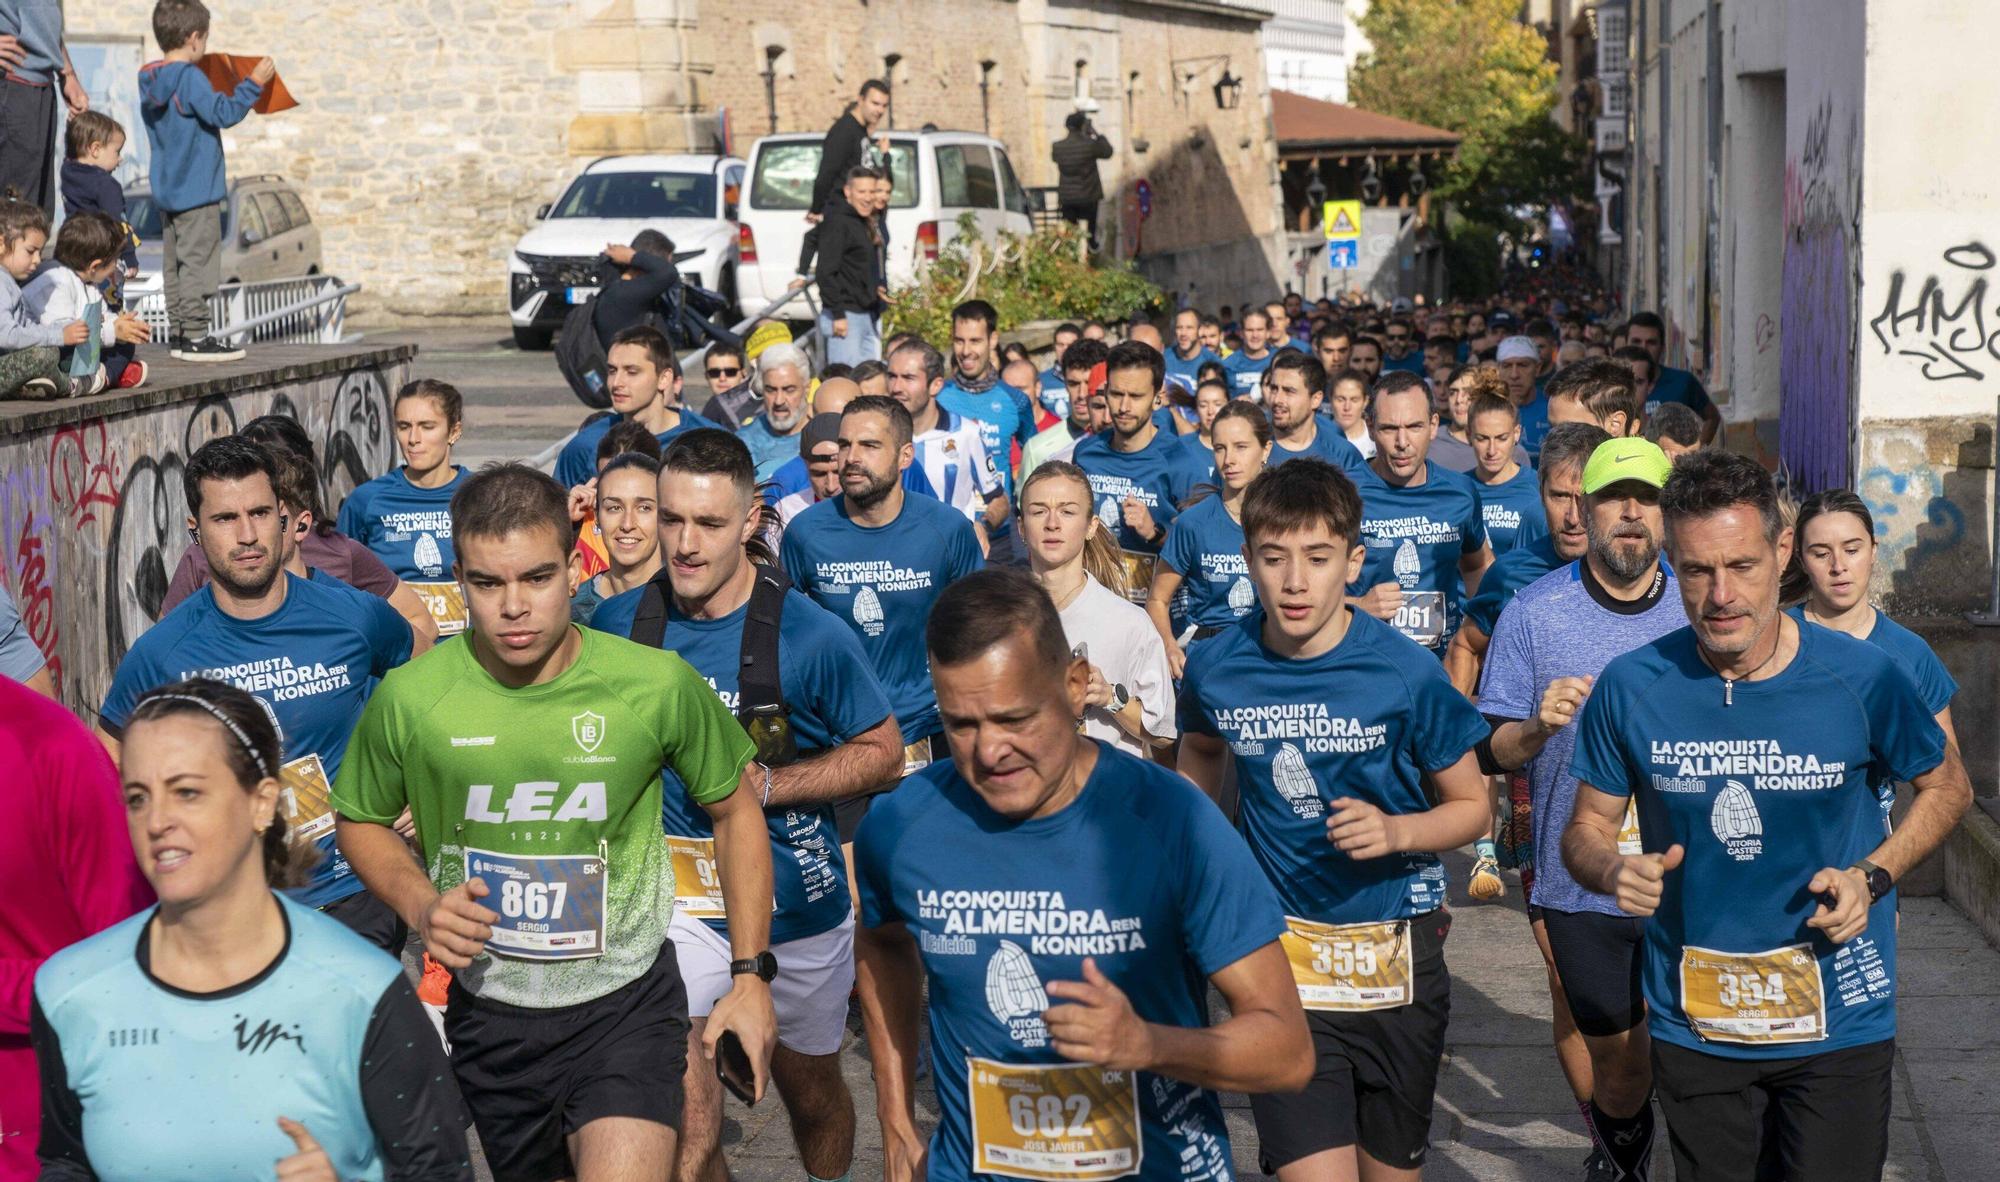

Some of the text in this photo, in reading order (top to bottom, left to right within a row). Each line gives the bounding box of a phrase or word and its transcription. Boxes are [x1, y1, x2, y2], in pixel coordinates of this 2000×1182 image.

[1089, 475, 1132, 486] CONQUISTA
[380, 511, 450, 522] LA CONQUISTA
[1360, 516, 1430, 528] LA CONQUISTA
[396, 520, 452, 532] ALMEND
[1378, 522, 1452, 538] ALMENDRA
[1417, 534, 1460, 544] KONKISTA
[1201, 553, 1212, 561] LA
[816, 560, 892, 572] LA CONQUISTA
[1214, 563, 1250, 574] ALME
[833, 568, 916, 584] ALMENDRA
[877, 578, 932, 592] KONKISTA
[202, 656, 294, 680] CONQUISTA
[234, 663, 348, 693] MENDRA REN
[273, 674, 351, 702] KONKISTA
[1214, 704, 1328, 722] LA CONQUISTA
[1218, 718, 1386, 740] DE LA ALMENDRA REN
[1306, 734, 1386, 752] KONKISTA
[1652, 740, 1782, 758] LA CONQUISTA
[298, 764, 316, 776] 10K
[1652, 754, 1846, 776] DE LA ALMENDRA REN
[1663, 775, 1706, 792] Edición
[1754, 772, 1844, 790] KONKISTA
[464, 781, 608, 824] LEA
[1291, 798, 1322, 807] VITORIA
[1294, 804, 1325, 814] GASTEIZ
[788, 824, 814, 838] LABORAL
[1727, 840, 1762, 848] VITORIA
[1727, 846, 1762, 856] GASTEIZ
[583, 864, 598, 874] 5K
[501, 880, 568, 920] 867
[916, 890, 1066, 912] LA CONQUISTA
[516, 922, 550, 933] SERGIO
[920, 908, 1142, 934] DE LA ALMENDRA REN
[929, 934, 977, 954] Edición
[1031, 932, 1147, 956] KONKISTA
[1311, 941, 1378, 976] 355
[1792, 954, 1808, 966] 10K
[1718, 972, 1788, 1007] 354
[1738, 1008, 1769, 1018] SERGIO
[1008, 1018, 1045, 1028] VITOR
[1010, 1028, 1052, 1040] GASTEI
[1101, 1071, 1124, 1085] 10K
[1008, 1094, 1094, 1138] 682
